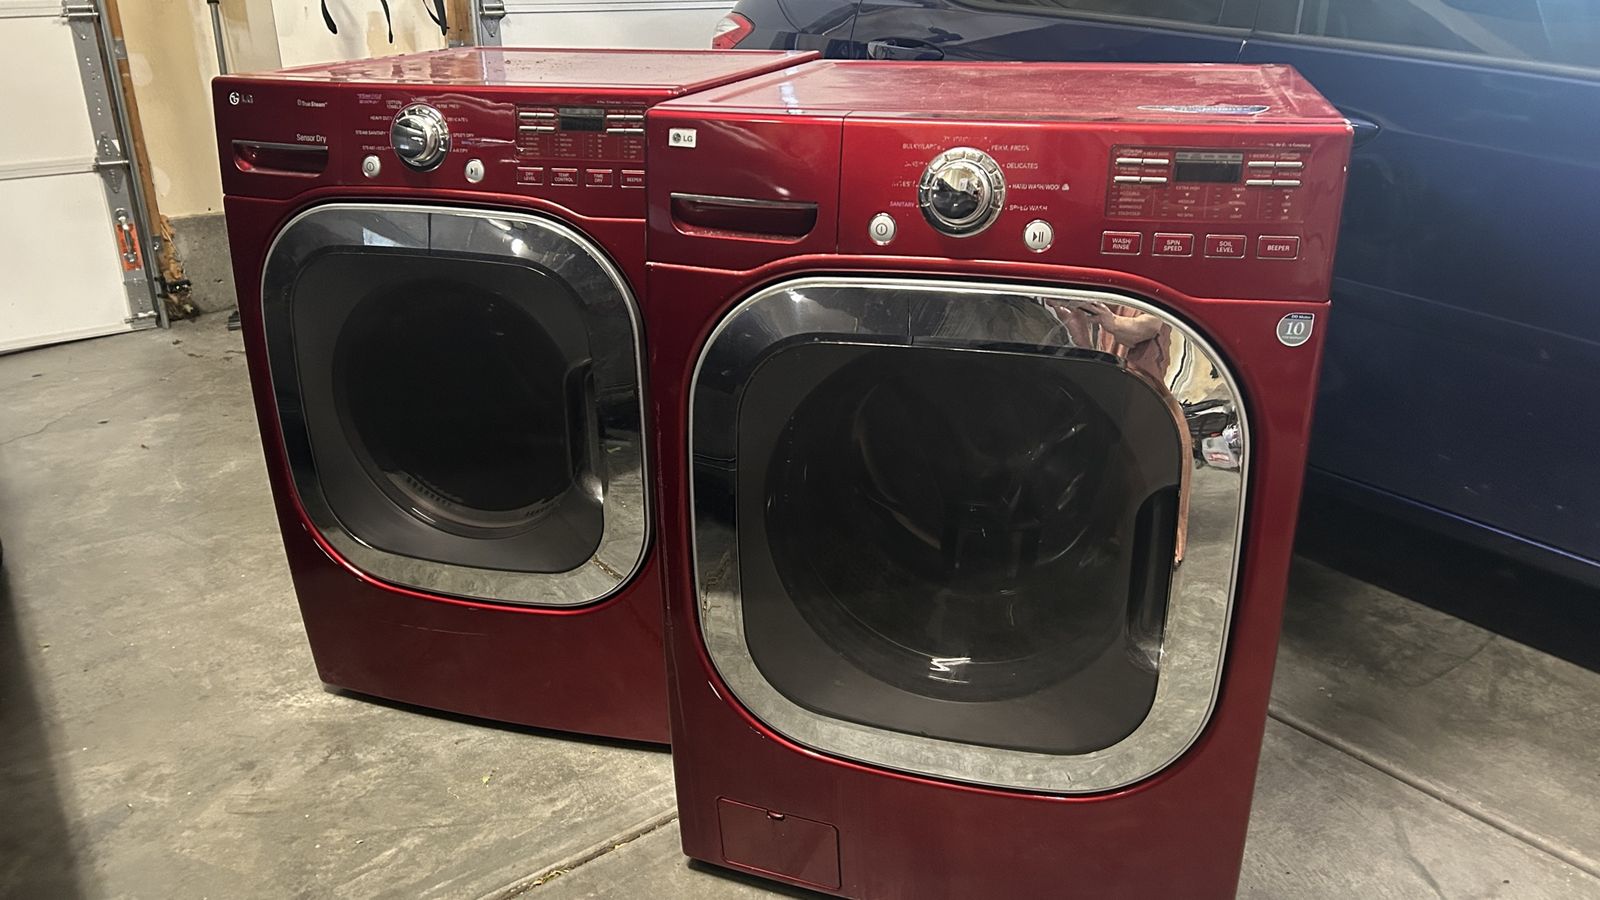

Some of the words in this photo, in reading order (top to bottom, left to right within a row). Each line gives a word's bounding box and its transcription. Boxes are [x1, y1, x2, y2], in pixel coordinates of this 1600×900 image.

[296, 133, 316, 142] Sensor
[315, 134, 327, 143] Dry
[683, 135, 694, 143] LG
[1006, 162, 1039, 170] DELICATES
[1112, 243, 1130, 251] RINSE
[1266, 244, 1290, 252] BEEPER
[1285, 321, 1305, 336] 10
